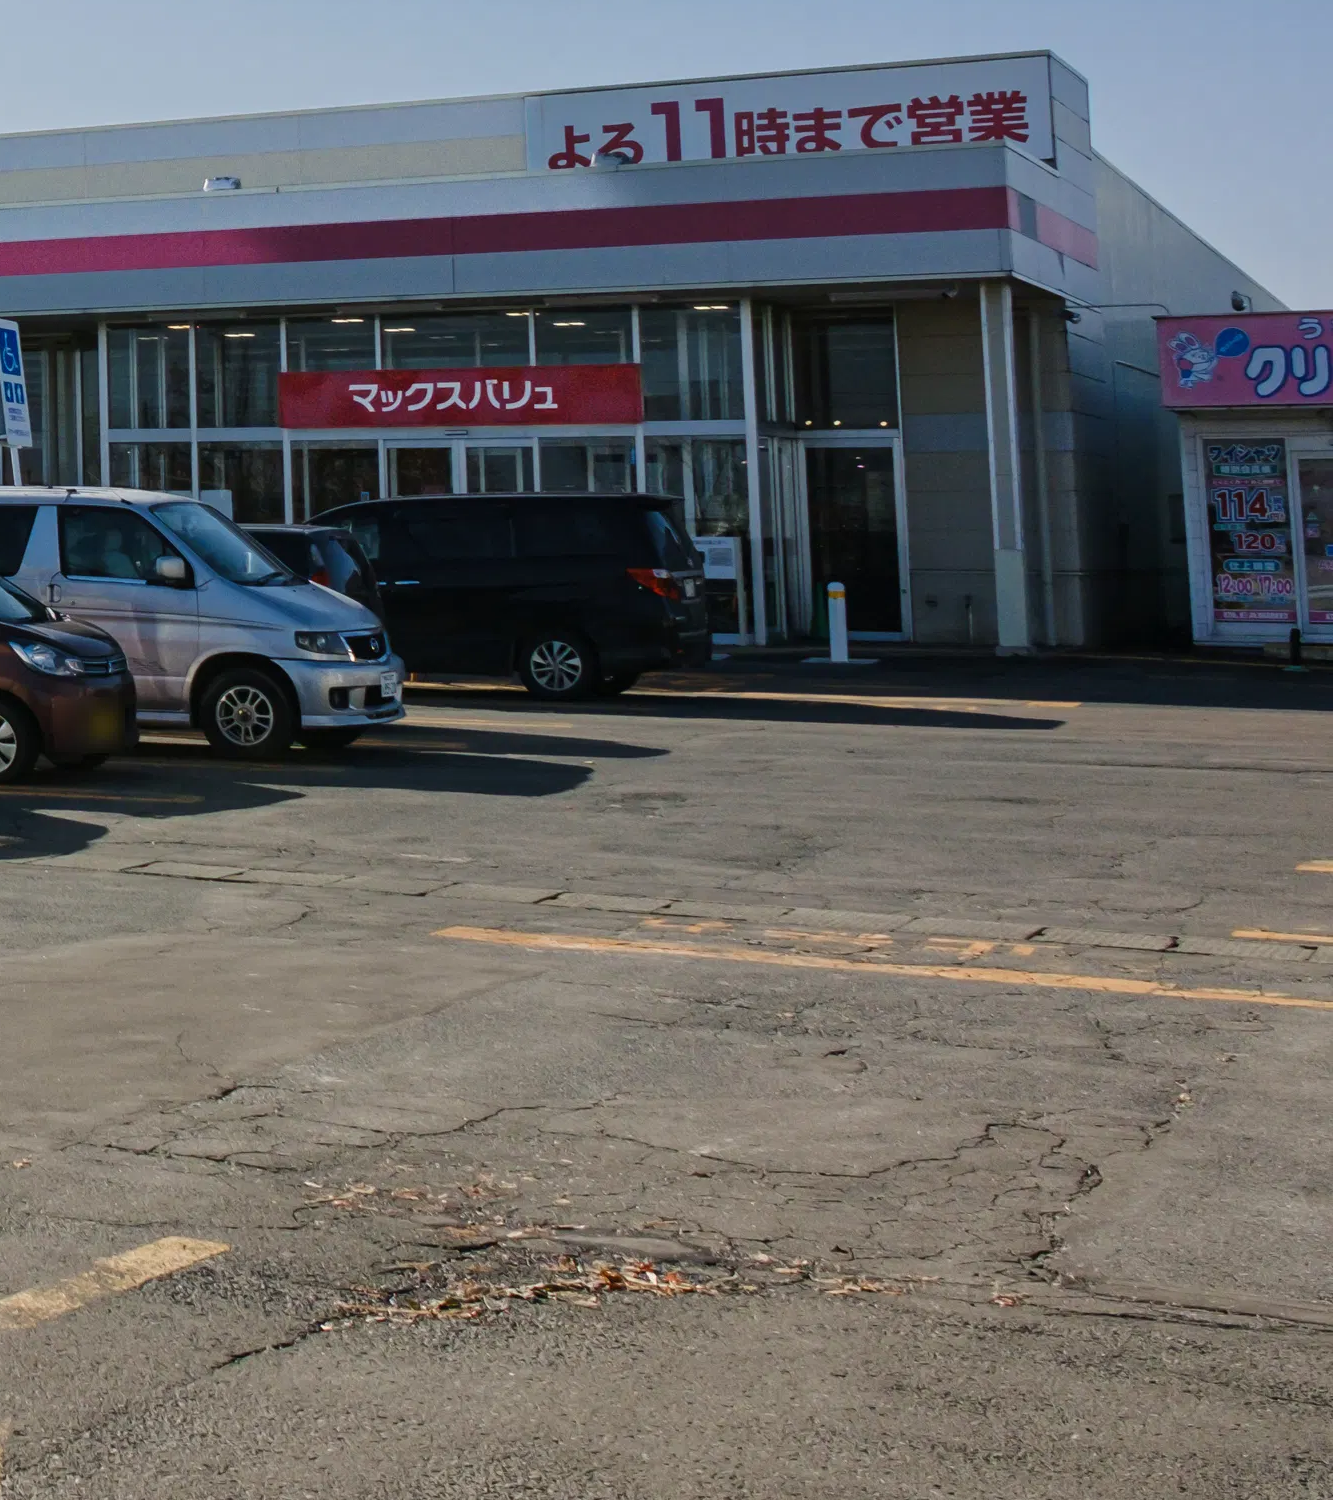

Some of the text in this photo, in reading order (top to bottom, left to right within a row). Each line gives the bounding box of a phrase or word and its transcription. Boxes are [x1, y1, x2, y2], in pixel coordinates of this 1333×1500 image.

[1298, 317, 1333, 340] う
[348, 379, 559, 413] マックスバリュ
[1208, 443, 1281, 462] ワイシャツ
[1214, 489, 1270, 521] 114
[1234, 533, 1276, 551] 120
